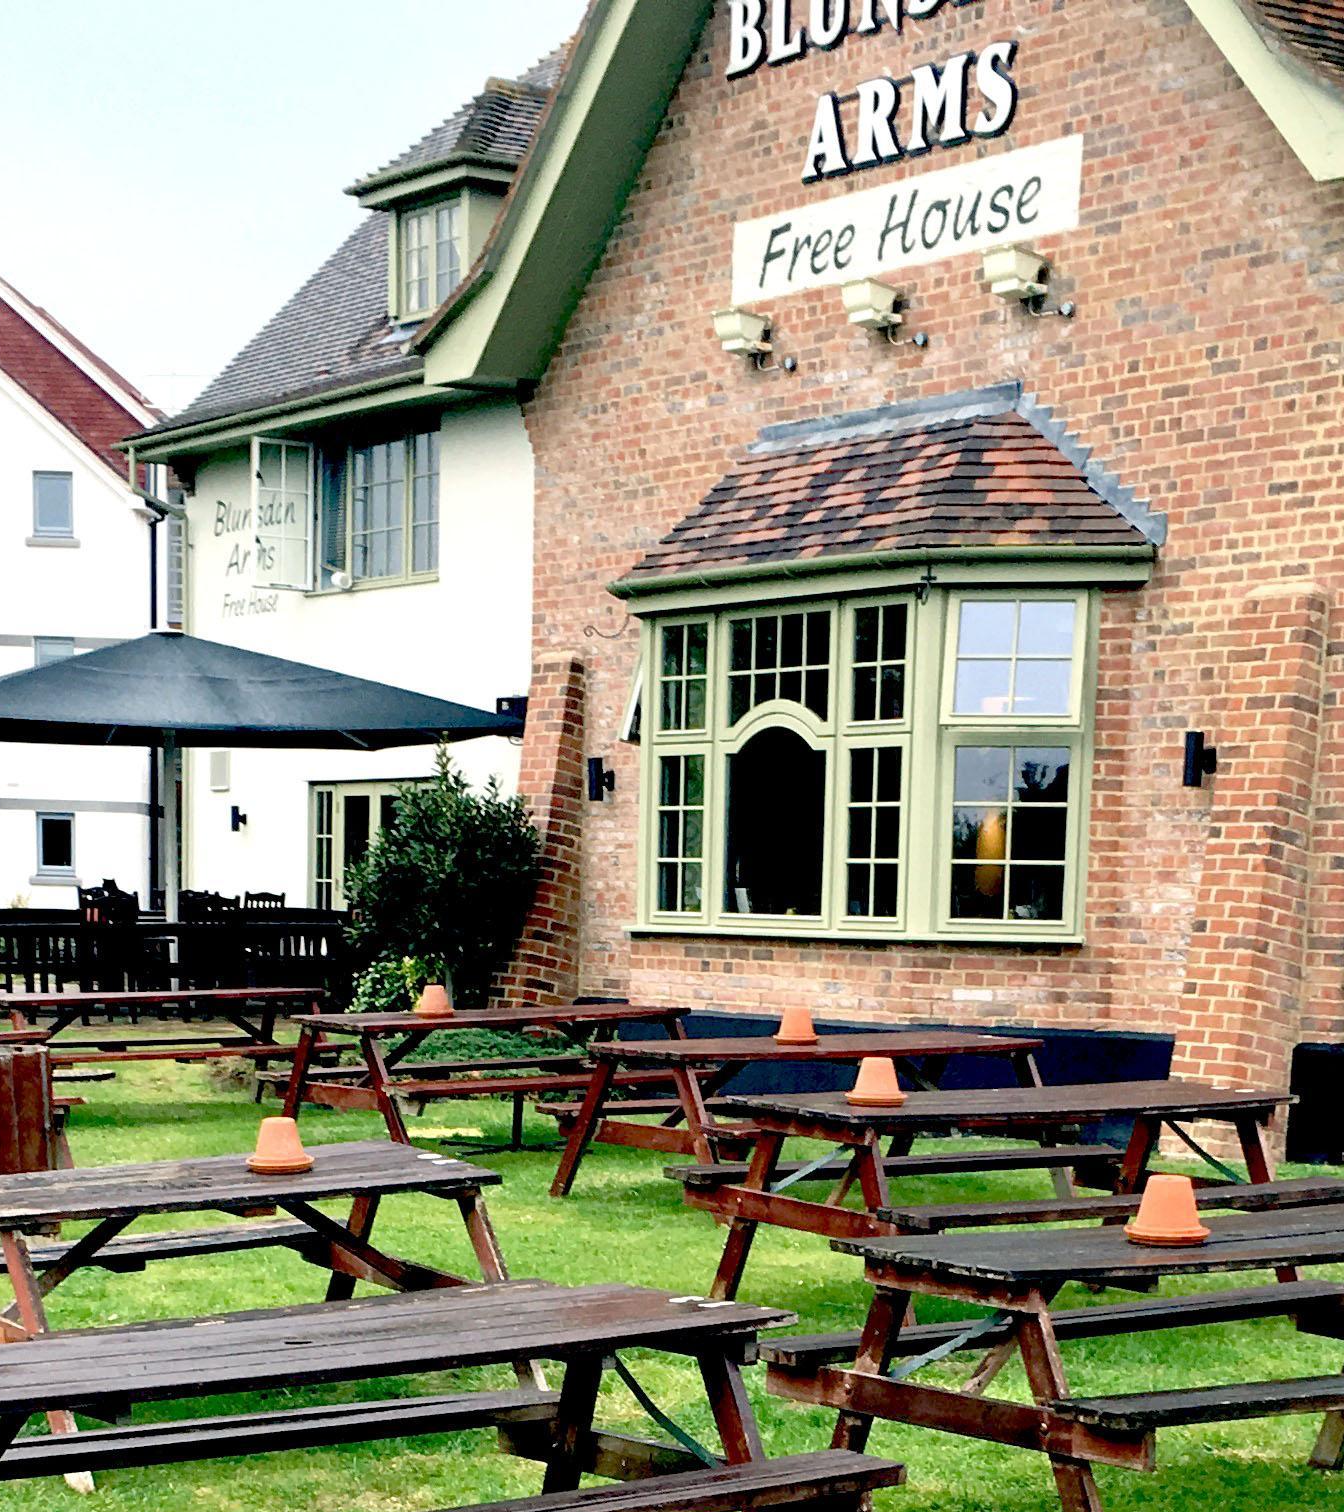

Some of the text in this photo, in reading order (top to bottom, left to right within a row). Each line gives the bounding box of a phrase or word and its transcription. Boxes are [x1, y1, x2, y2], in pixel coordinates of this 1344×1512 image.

[802, 40, 1018, 184] ARMS
[758, 174, 1042, 289] Free House
[222, 592, 279, 618] Free House
